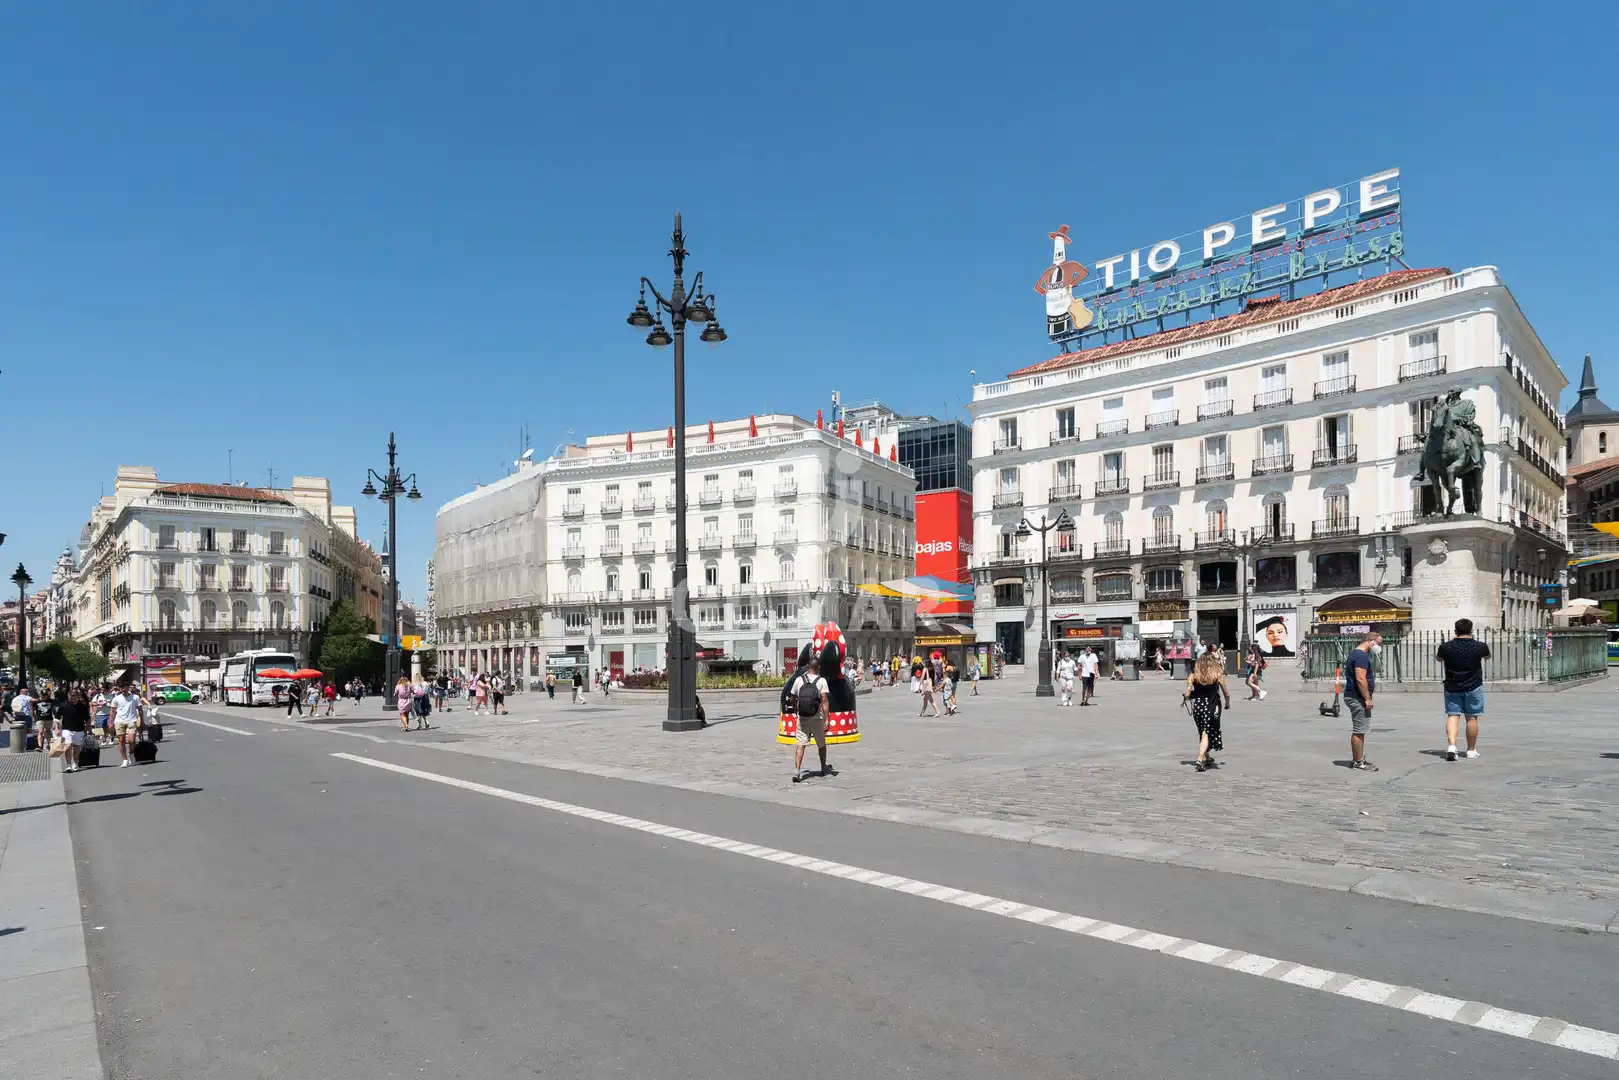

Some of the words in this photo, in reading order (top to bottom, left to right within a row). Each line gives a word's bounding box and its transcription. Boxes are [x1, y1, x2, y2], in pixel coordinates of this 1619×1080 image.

[1093, 293, 1124, 307] SOL
[1127, 284, 1148, 298] DE
[1253, 212, 1399, 262] EMBOTELLADO
[1095, 239, 1181, 289] TIO
[1203, 167, 1400, 260] PEPE
[1289, 230, 1405, 281] BYASS
[915, 539, 953, 556] bajas
